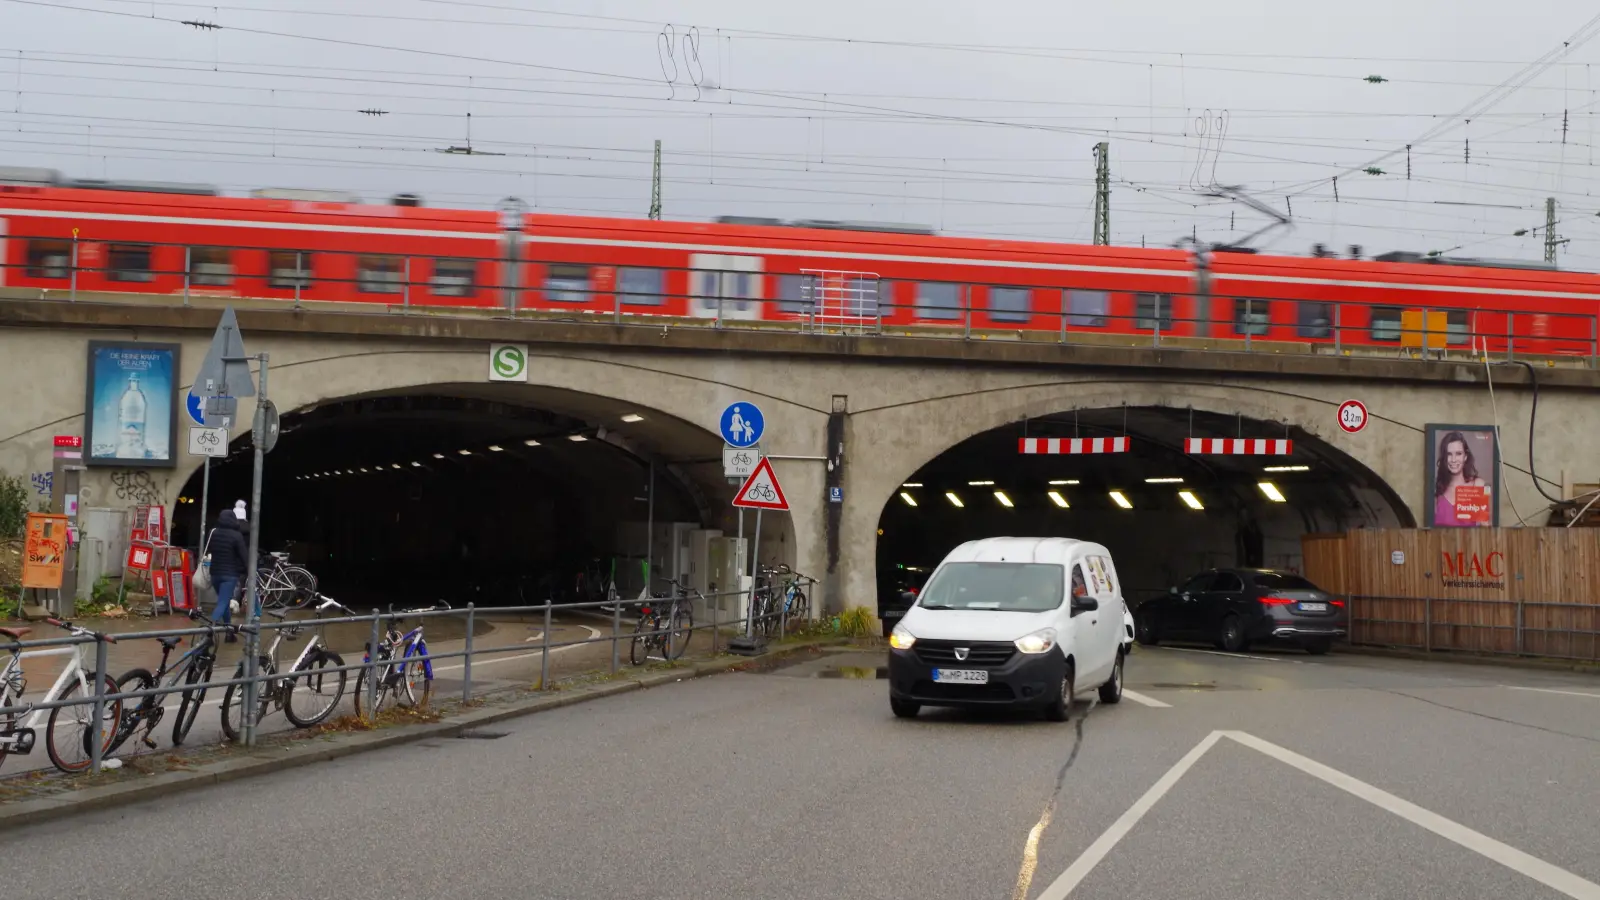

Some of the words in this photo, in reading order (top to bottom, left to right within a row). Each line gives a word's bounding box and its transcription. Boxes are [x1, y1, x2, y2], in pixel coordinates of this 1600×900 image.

[498, 349, 519, 375] S
[1456, 503, 1480, 512] Parship
[1442, 551, 1505, 578] MAC
[1442, 579, 1505, 590] Verkehrssicherung
